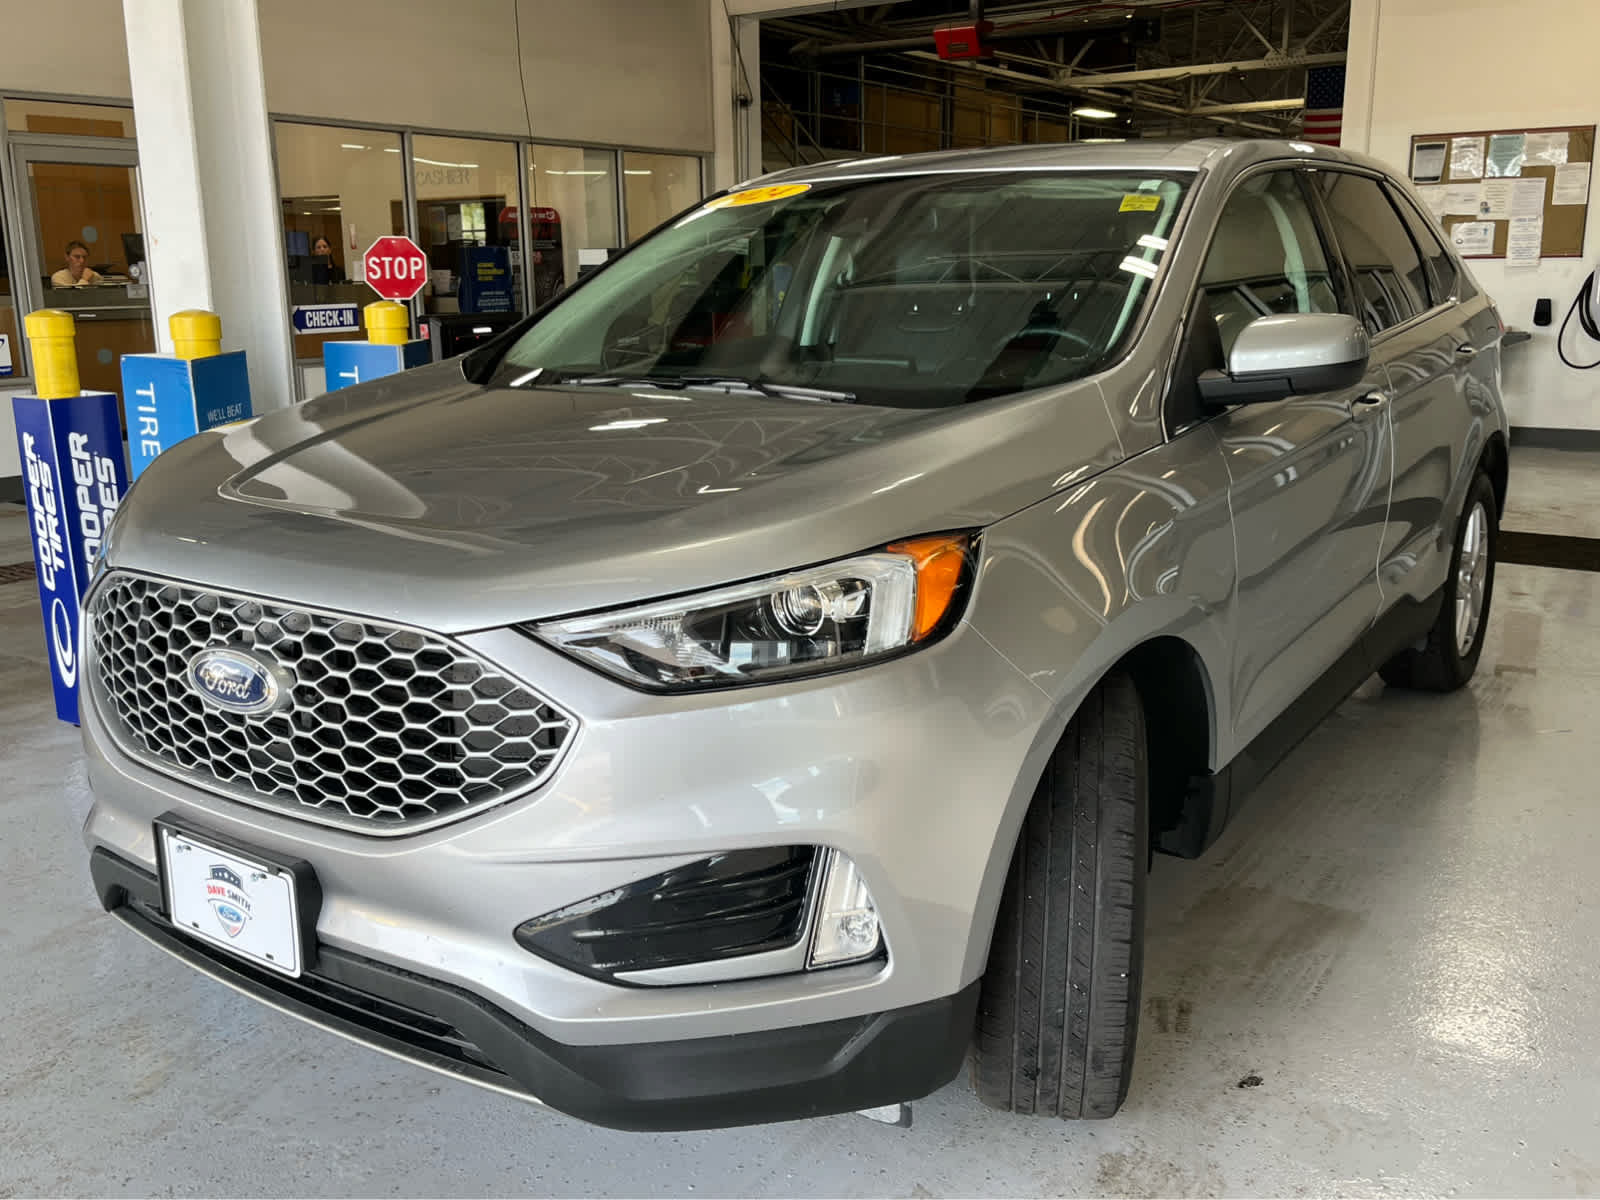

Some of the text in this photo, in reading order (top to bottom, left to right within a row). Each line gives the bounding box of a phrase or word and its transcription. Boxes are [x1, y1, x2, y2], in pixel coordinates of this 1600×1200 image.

[368, 256, 423, 279] STOP
[305, 309, 354, 328] CHECK-IN
[136, 382, 161, 456] TIRE
[207, 402, 243, 422] WE'LL BEAT
[23, 432, 56, 591] COOPER
[38, 459, 65, 572] TIRES
[200, 663, 251, 699] Ford
[207, 884, 251, 911] DAVE SMITH
